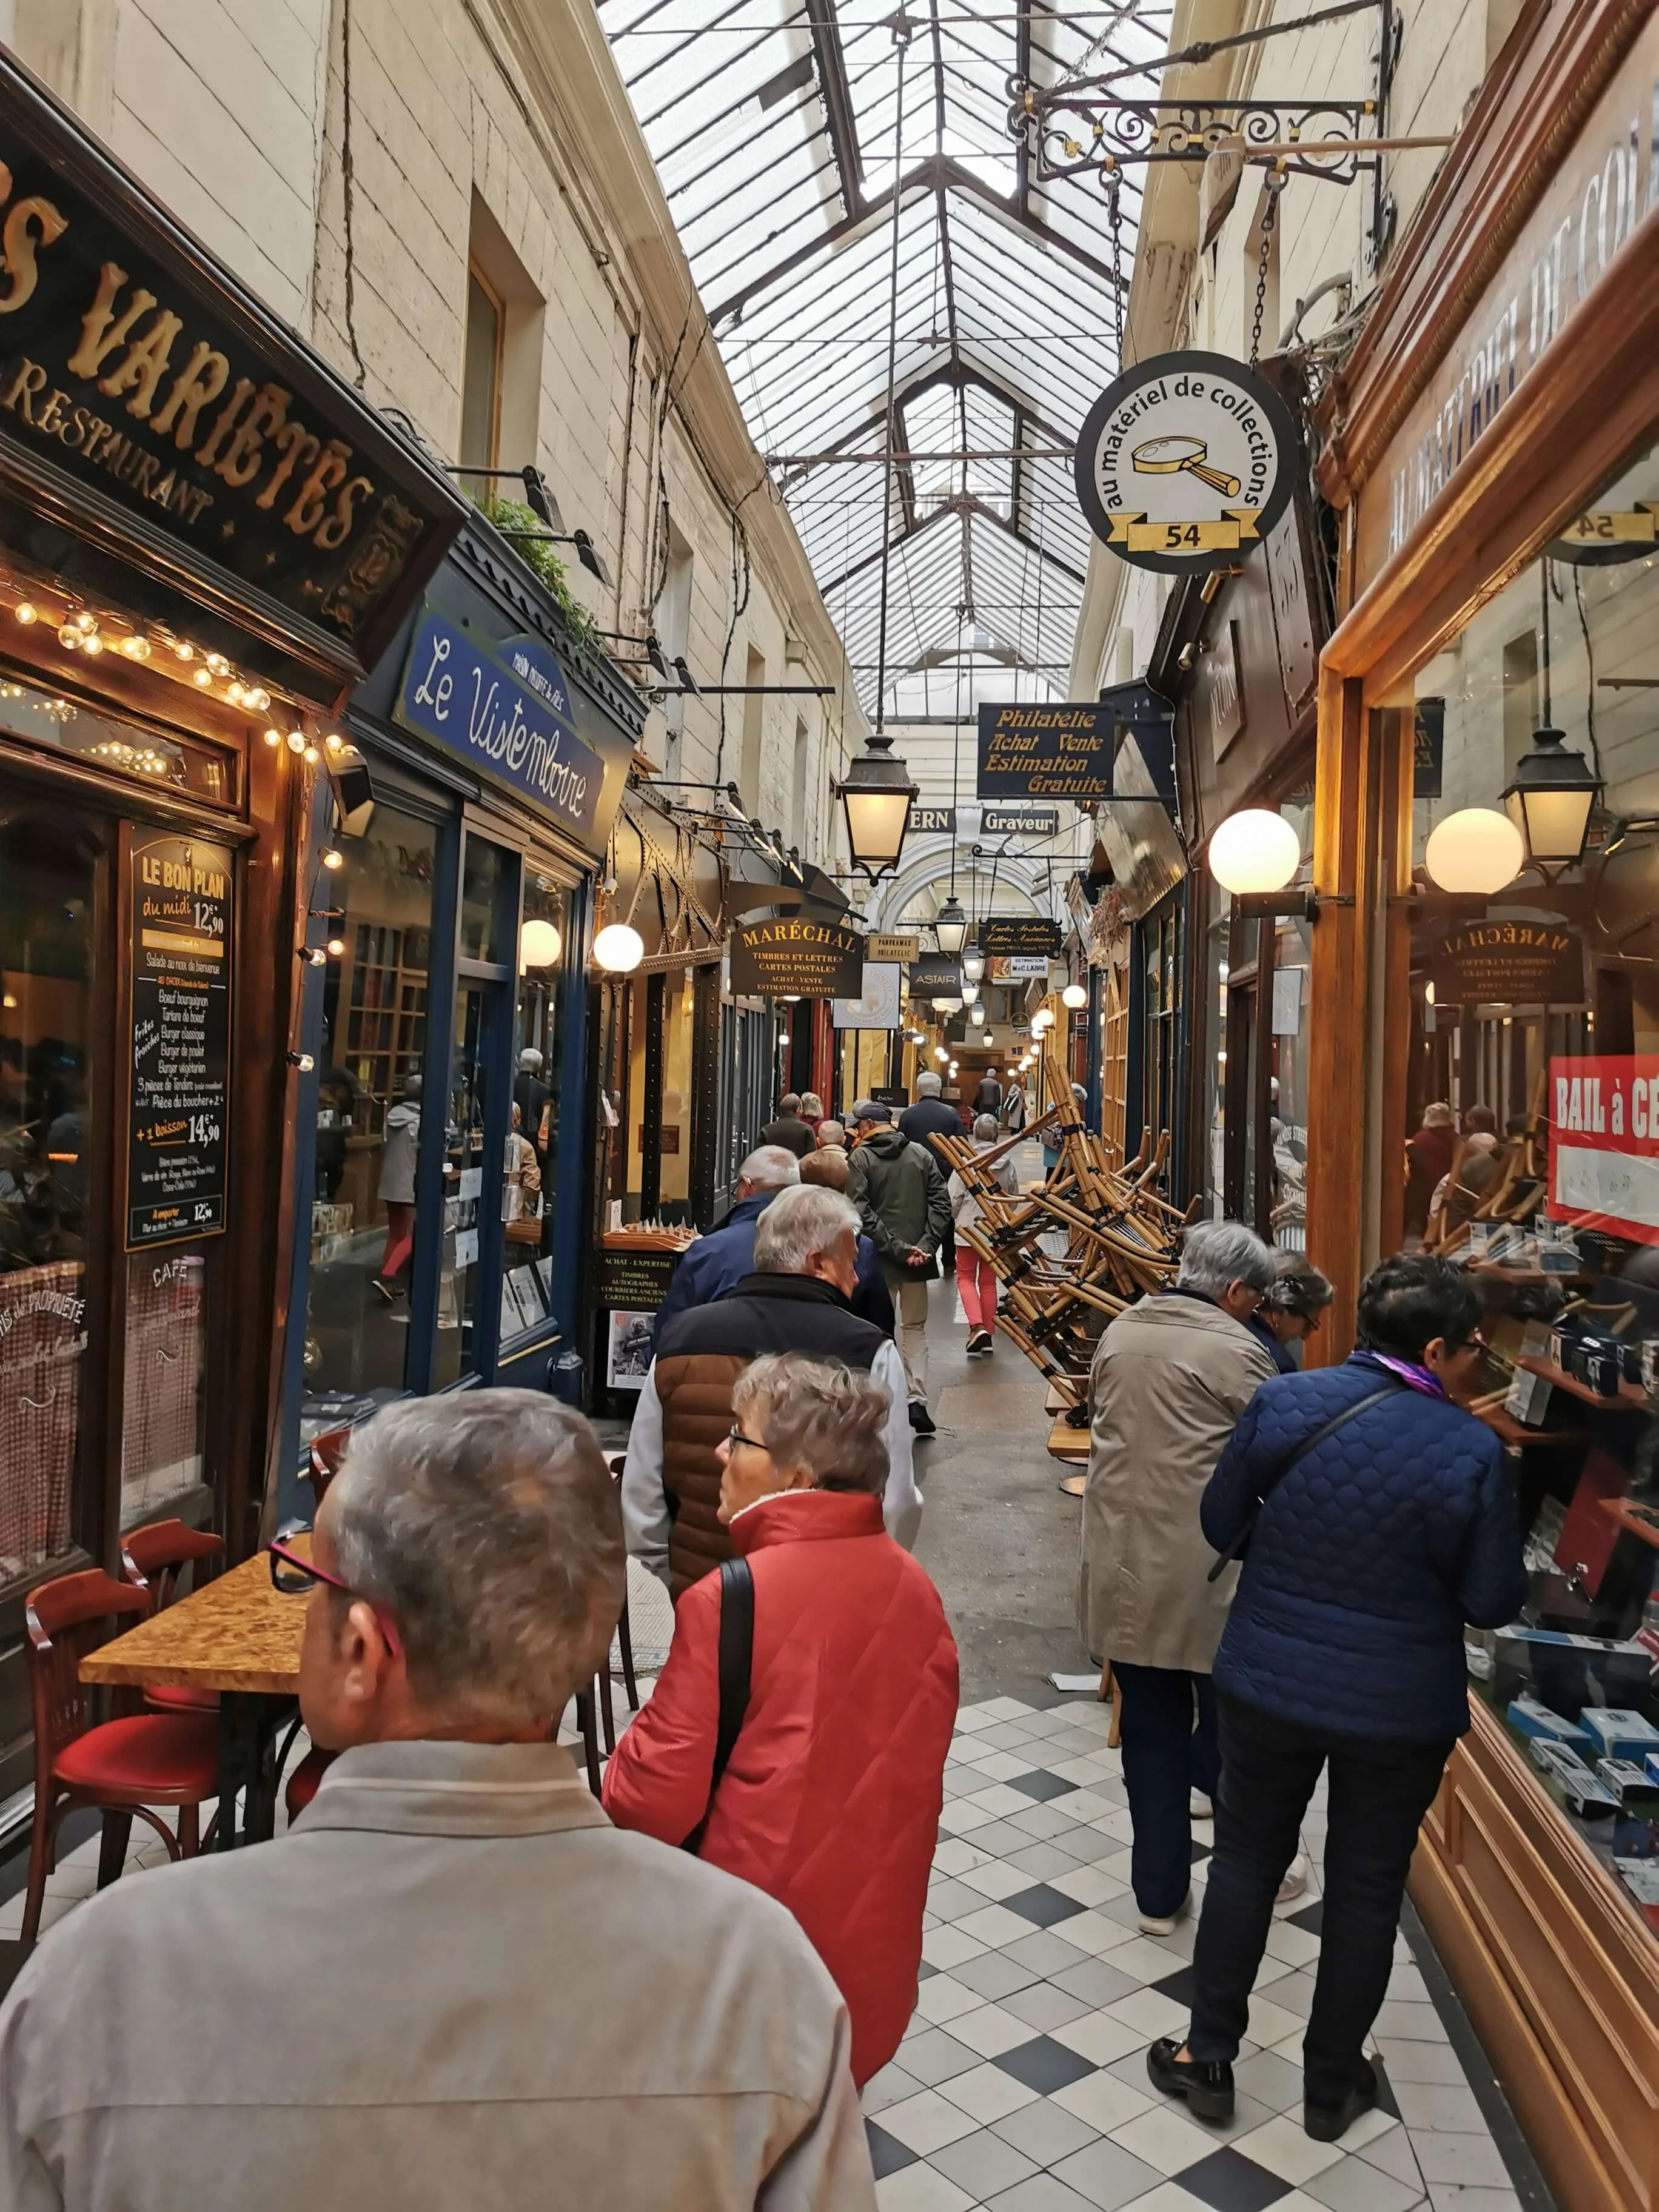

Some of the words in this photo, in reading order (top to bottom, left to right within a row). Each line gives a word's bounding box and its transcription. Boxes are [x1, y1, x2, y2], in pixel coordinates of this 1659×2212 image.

[1174, 375, 1205, 398] de
[67, 261, 374, 551] VARIÉTÉS
[1102, 380, 1168, 472] matériel
[2, 357, 213, 525] RESTAURANT
[1210, 388, 1273, 507] collections
[1102, 479, 1123, 509] au
[1165, 525, 1201, 548] 54
[414, 635, 453, 721] Le
[469, 666, 588, 819] Vistemboire
[996, 709, 1097, 728] Philatélie
[988, 732, 1041, 751] Achat
[1058, 733, 1104, 752] Vente
[984, 754, 1088, 773] Estimation
[1028, 774, 1108, 794] Gratuite
[909, 810, 949, 830] ERN
[985, 812, 1054, 832] Graveur
[142, 856, 161, 886] LE
[163, 860, 191, 893] BON
[193, 867, 224, 900] PLAN
[143, 896, 161, 917] du
[163, 893, 192, 916] midi
[742, 919, 856, 954] MARÉCHAL
[877, 939, 912, 947] PANORAMAS
[146, 951, 166, 968] Salade
[188, 959, 195, 971] de
[752, 951, 790, 960] TIMBRES
[805, 953, 844, 963] LETTRES
[759, 962, 792, 971] CARTES
[794, 964, 836, 974] POSTALES
[914, 974, 957, 985] ASTAIR
[183, 1008, 189, 1022] de
[161, 1024, 181, 1043] Burger
[181, 1026, 205, 1048] classique
[161, 1042, 180, 1060] Burger
[181, 1043, 188, 1056] de
[158, 1059, 178, 1078] Burger
[137, 1077, 144, 1091] 3
[164, 1077, 172, 1091] de
[173, 1094, 181, 1108] du
[183, 1093, 208, 1107] boucher
[1557, 1077, 1606, 1134] BAIL
[1612, 1078, 1624, 1136] à
[155, 1119, 187, 1137] boisson
[605, 1257, 628, 1265] ACHAT
[633, 1259, 671, 1268] EXPERTISE
[611, 1279, 659, 1287] AUTOGRAPHES
[29, 1290, 87, 1324] PROPRIÉTÉ
